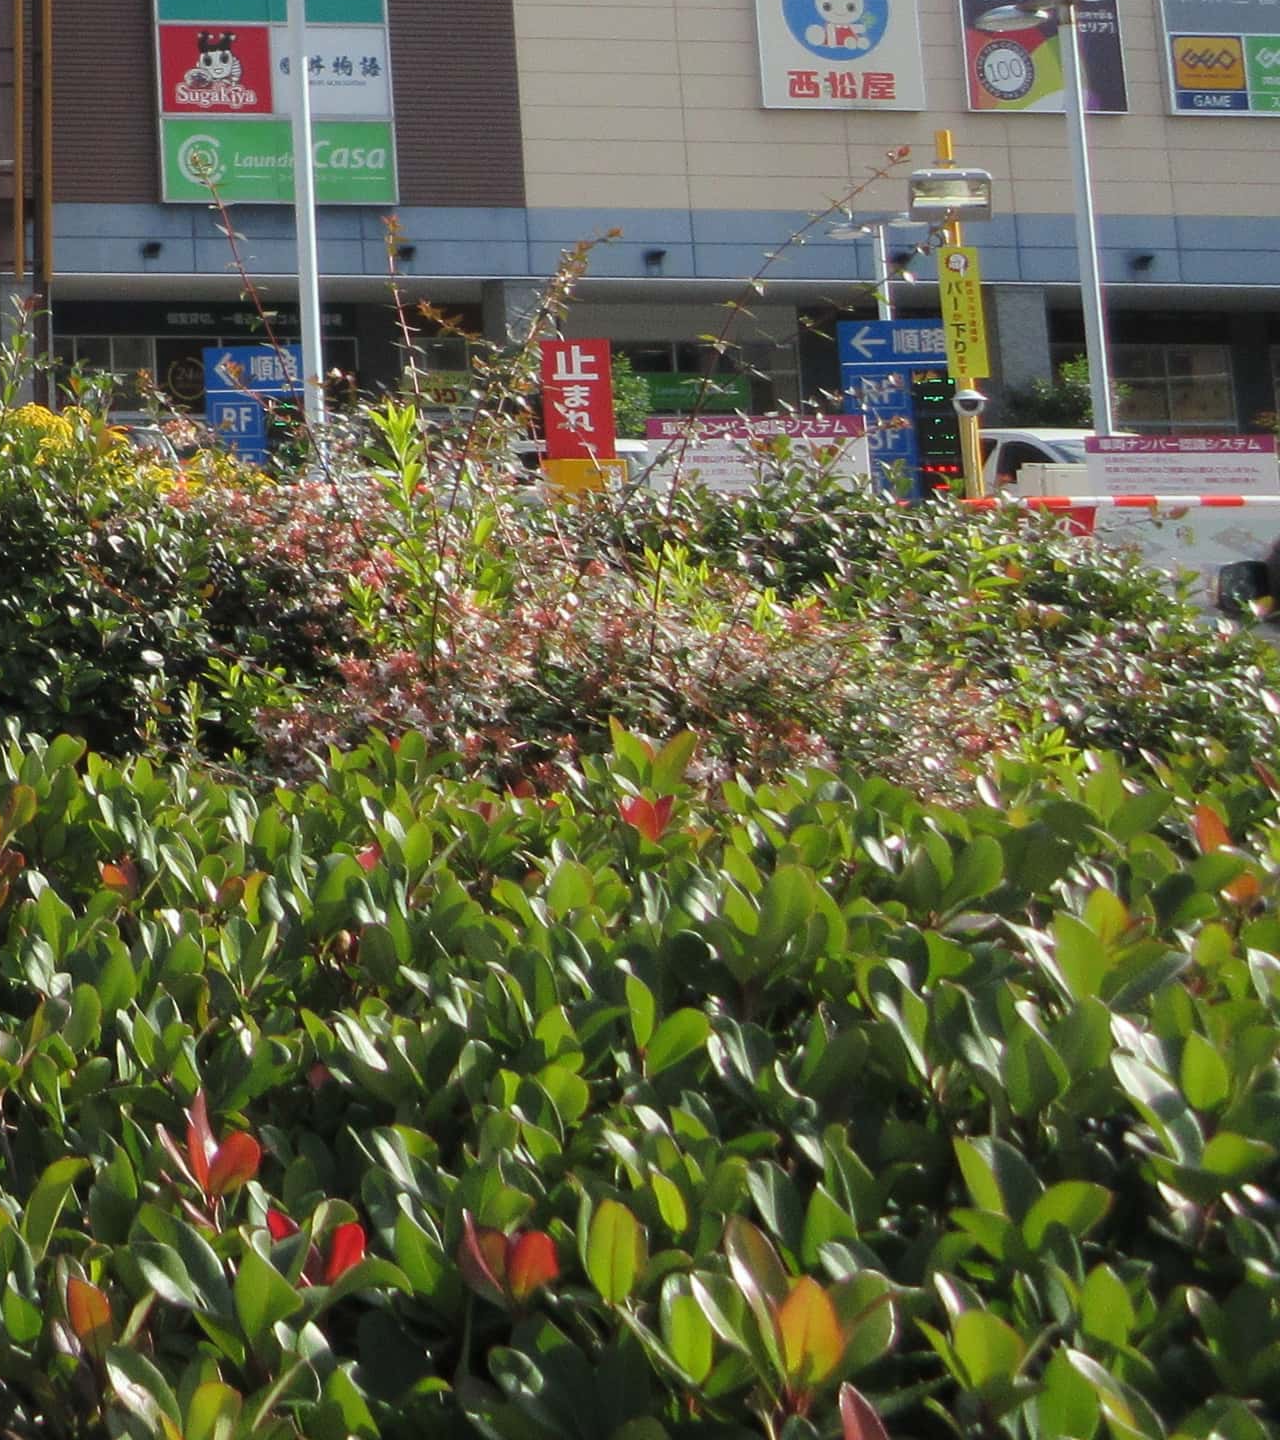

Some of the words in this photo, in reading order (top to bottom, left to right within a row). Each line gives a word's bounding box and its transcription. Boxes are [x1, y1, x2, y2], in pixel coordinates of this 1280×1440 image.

[986, 58, 1024, 83] 100
[175, 84, 257, 108] Sugakiya
[787, 70, 897, 100] 西松屋
[1193, 94, 1232, 108] GAME
[233, 151, 293, 168] Laund
[311, 141, 386, 169] Casa
[893, 329, 945, 354] 順路
[250, 356, 298, 382] 順路
[552, 345, 599, 433] 止まれ
[222, 407, 252, 433] RF
